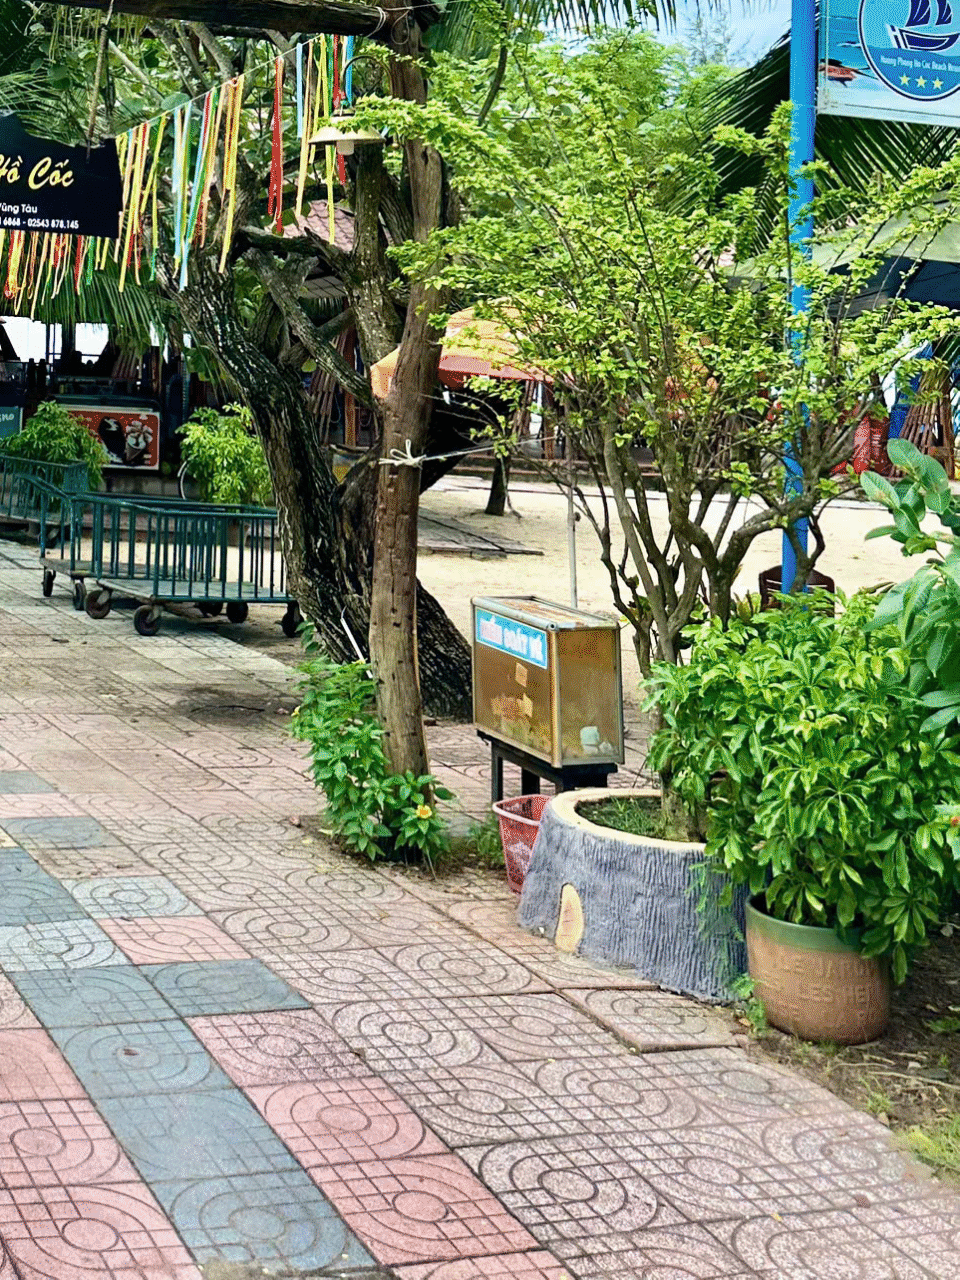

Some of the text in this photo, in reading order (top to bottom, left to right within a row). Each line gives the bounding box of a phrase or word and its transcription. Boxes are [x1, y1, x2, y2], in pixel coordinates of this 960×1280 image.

[28, 157, 75, 190] Cốc
[21, 203, 38, 214] Tàu
[27, 218, 50, 228] 02543
